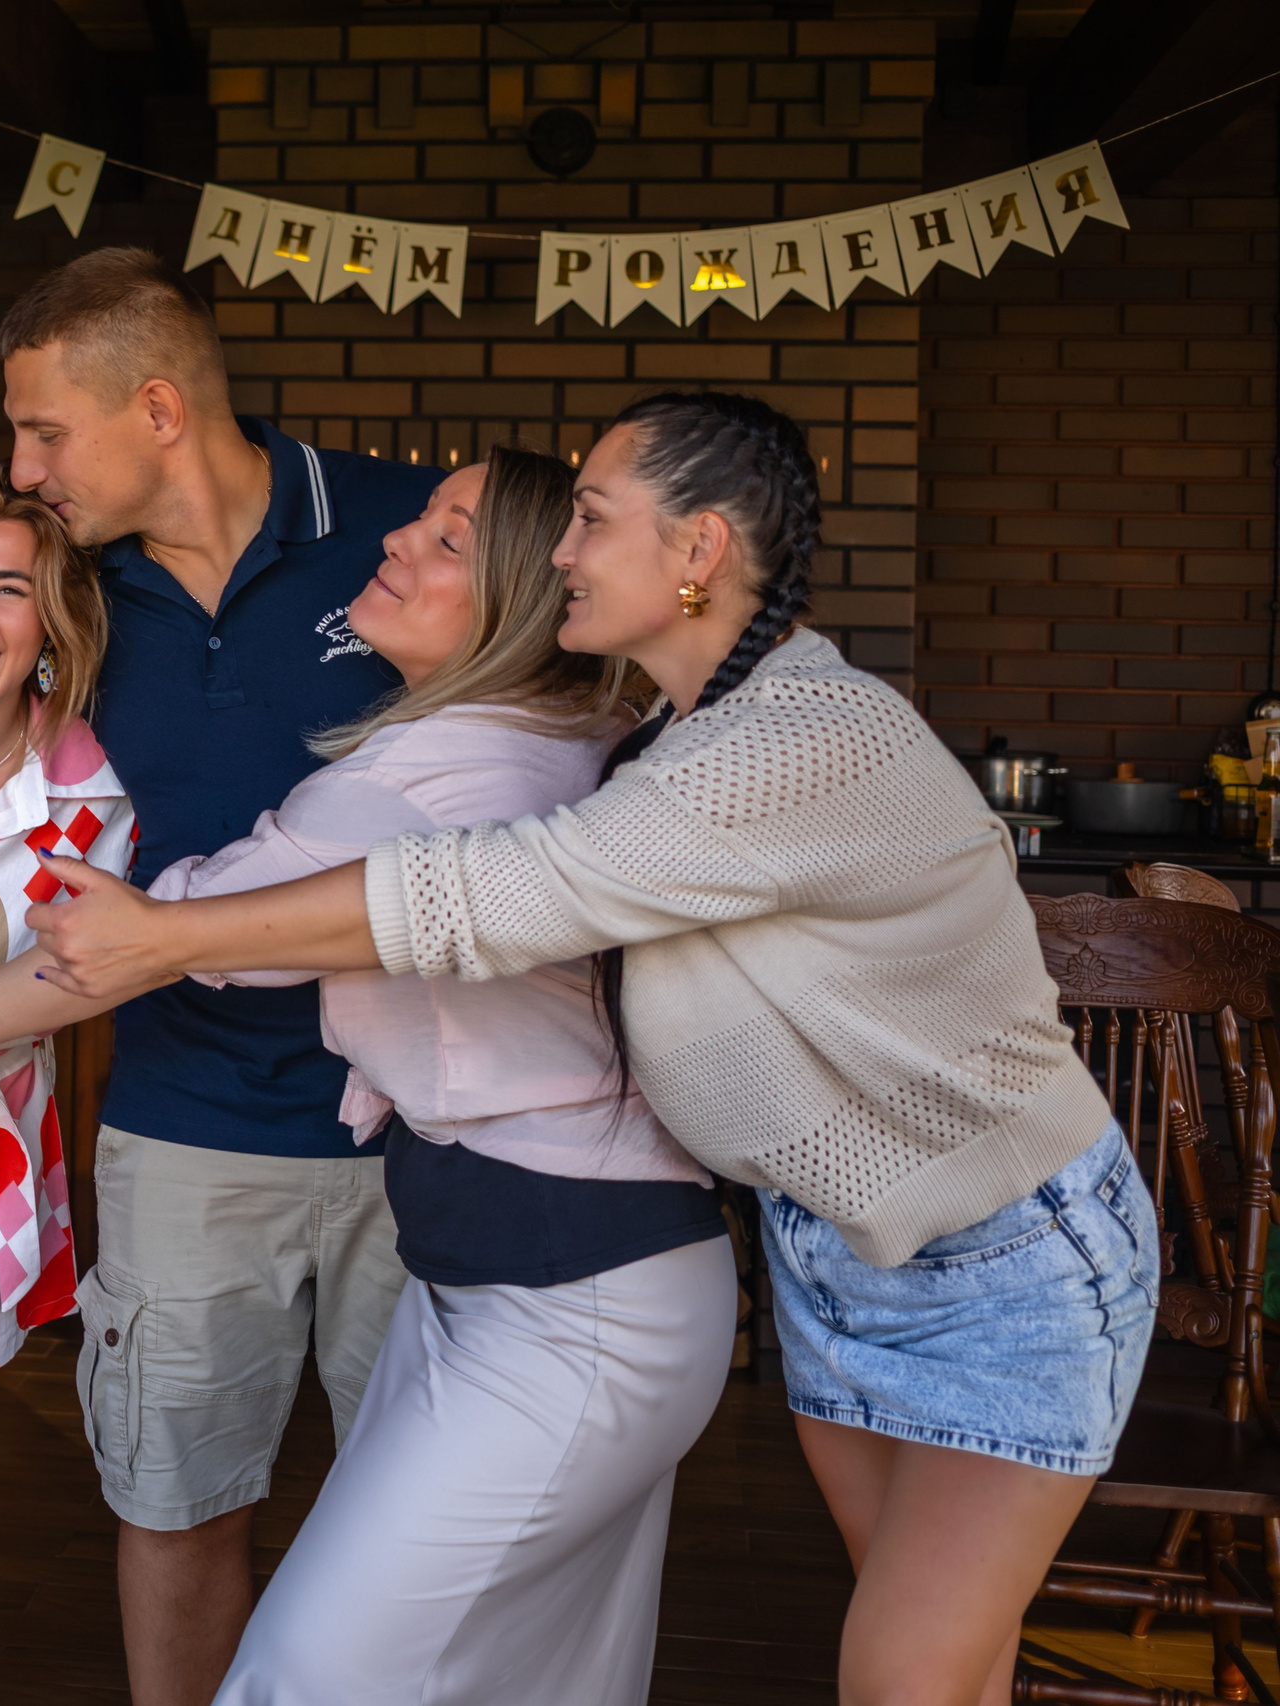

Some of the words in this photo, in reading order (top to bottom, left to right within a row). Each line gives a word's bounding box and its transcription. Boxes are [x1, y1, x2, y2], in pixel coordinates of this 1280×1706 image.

[207, 207, 453, 284] ДНЁМ
[553, 165, 1102, 292] РОЖДЕНИЯ
[314, 612, 336, 635] PAUL
[335, 607, 344, 617] &
